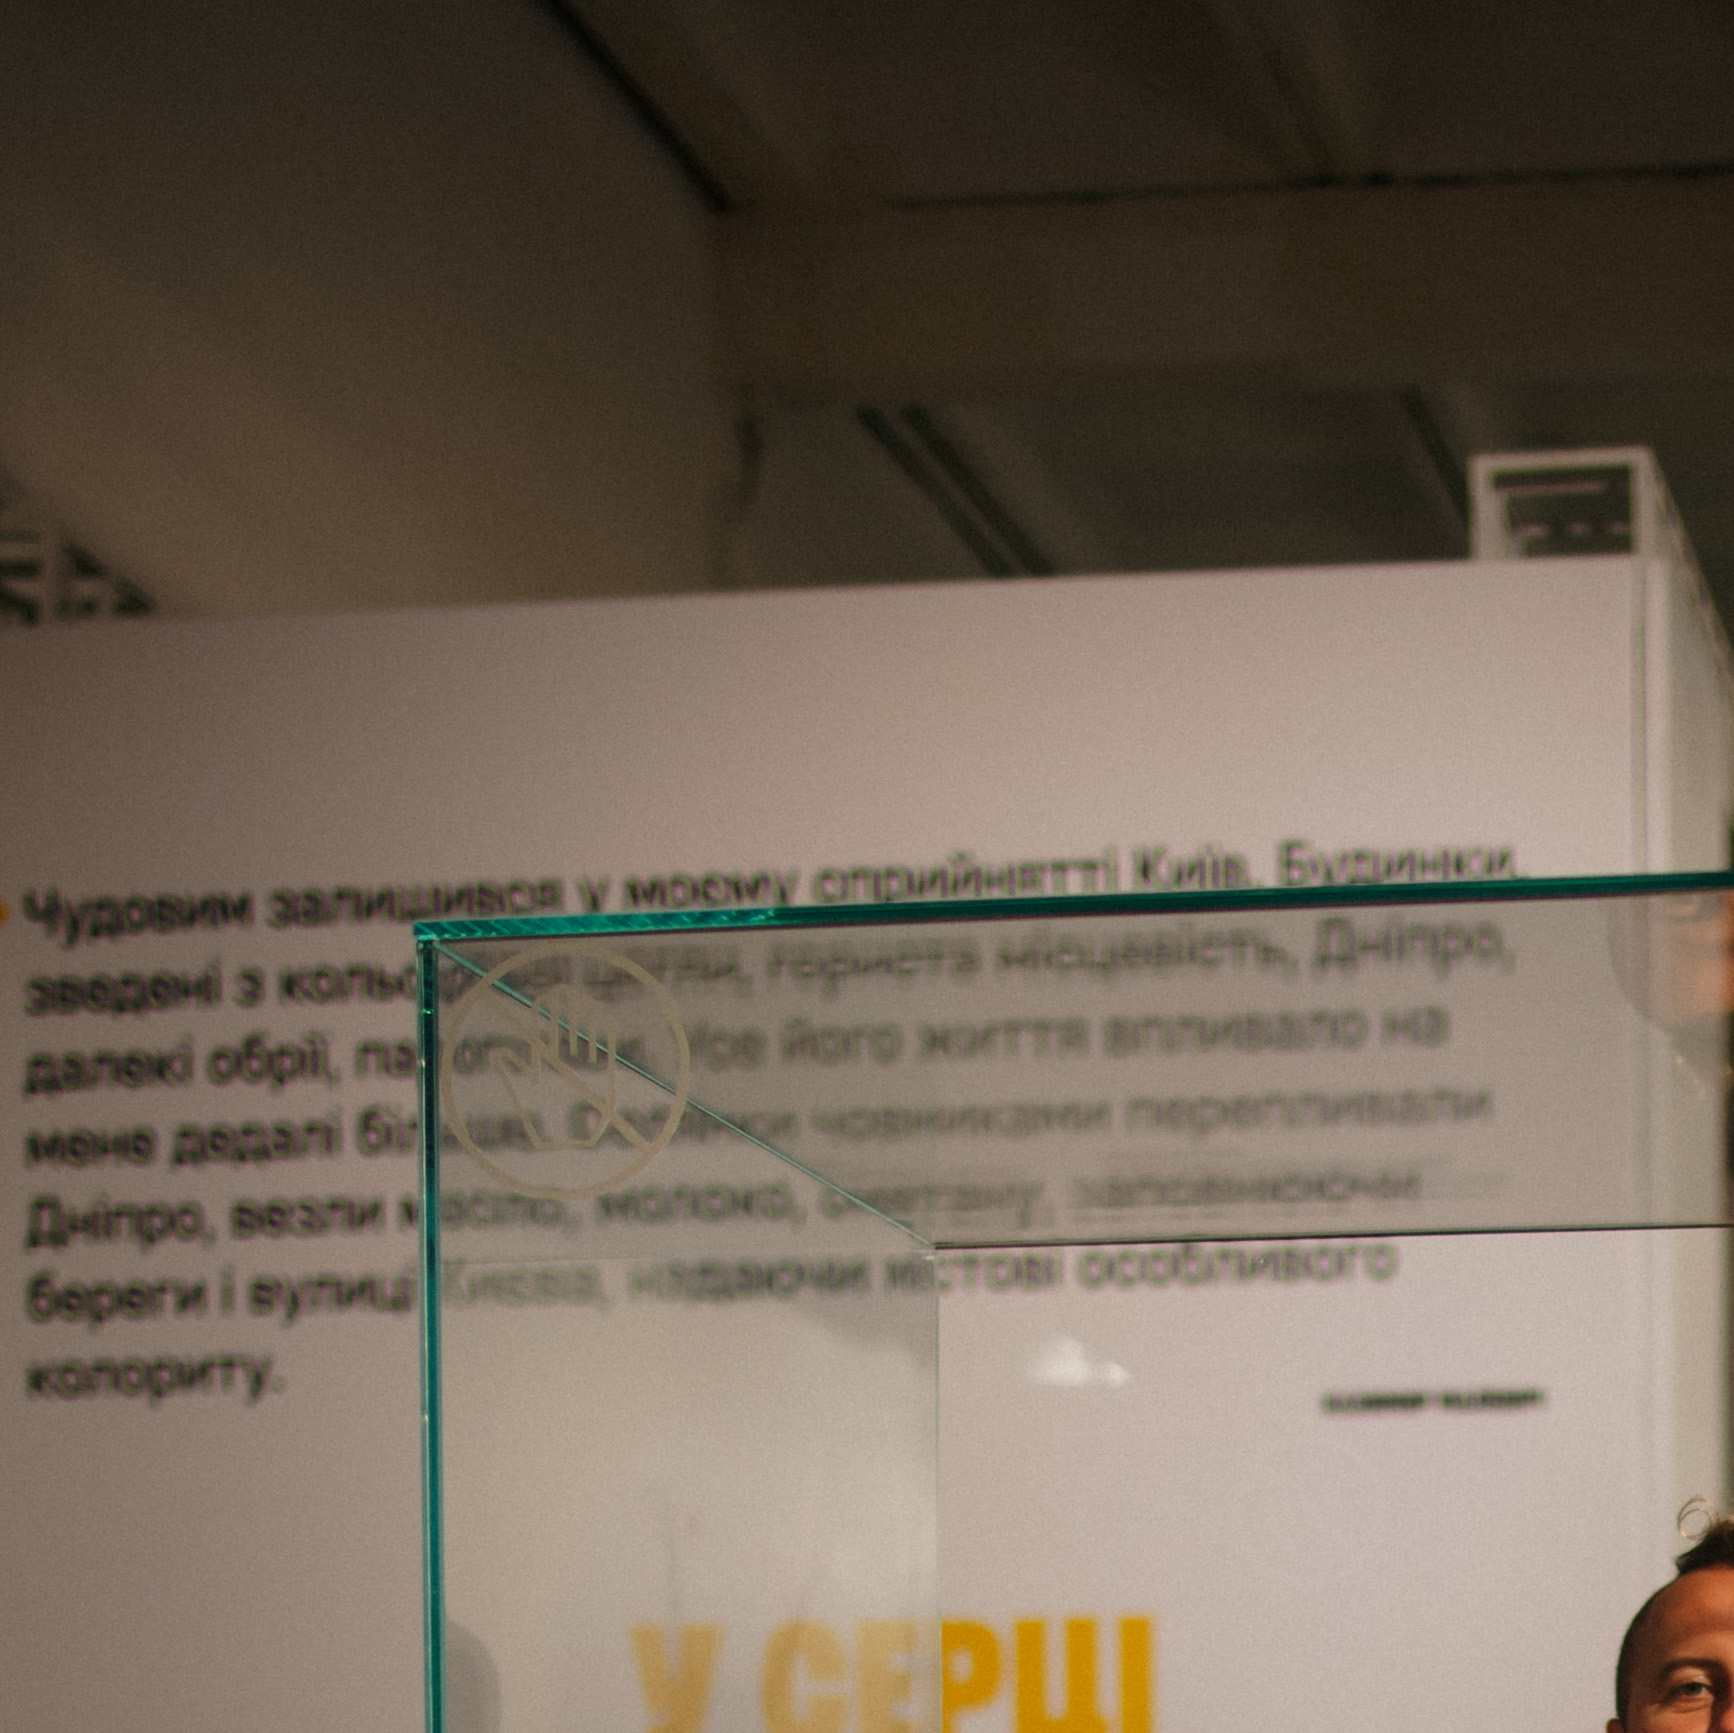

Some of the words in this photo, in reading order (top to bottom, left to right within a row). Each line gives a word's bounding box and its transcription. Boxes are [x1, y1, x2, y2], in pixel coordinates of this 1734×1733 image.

[24, 890, 254, 945] Чудовим
[24, 1042, 193, 1095] далекі
[26, 1192, 216, 1252] Дніпро,
